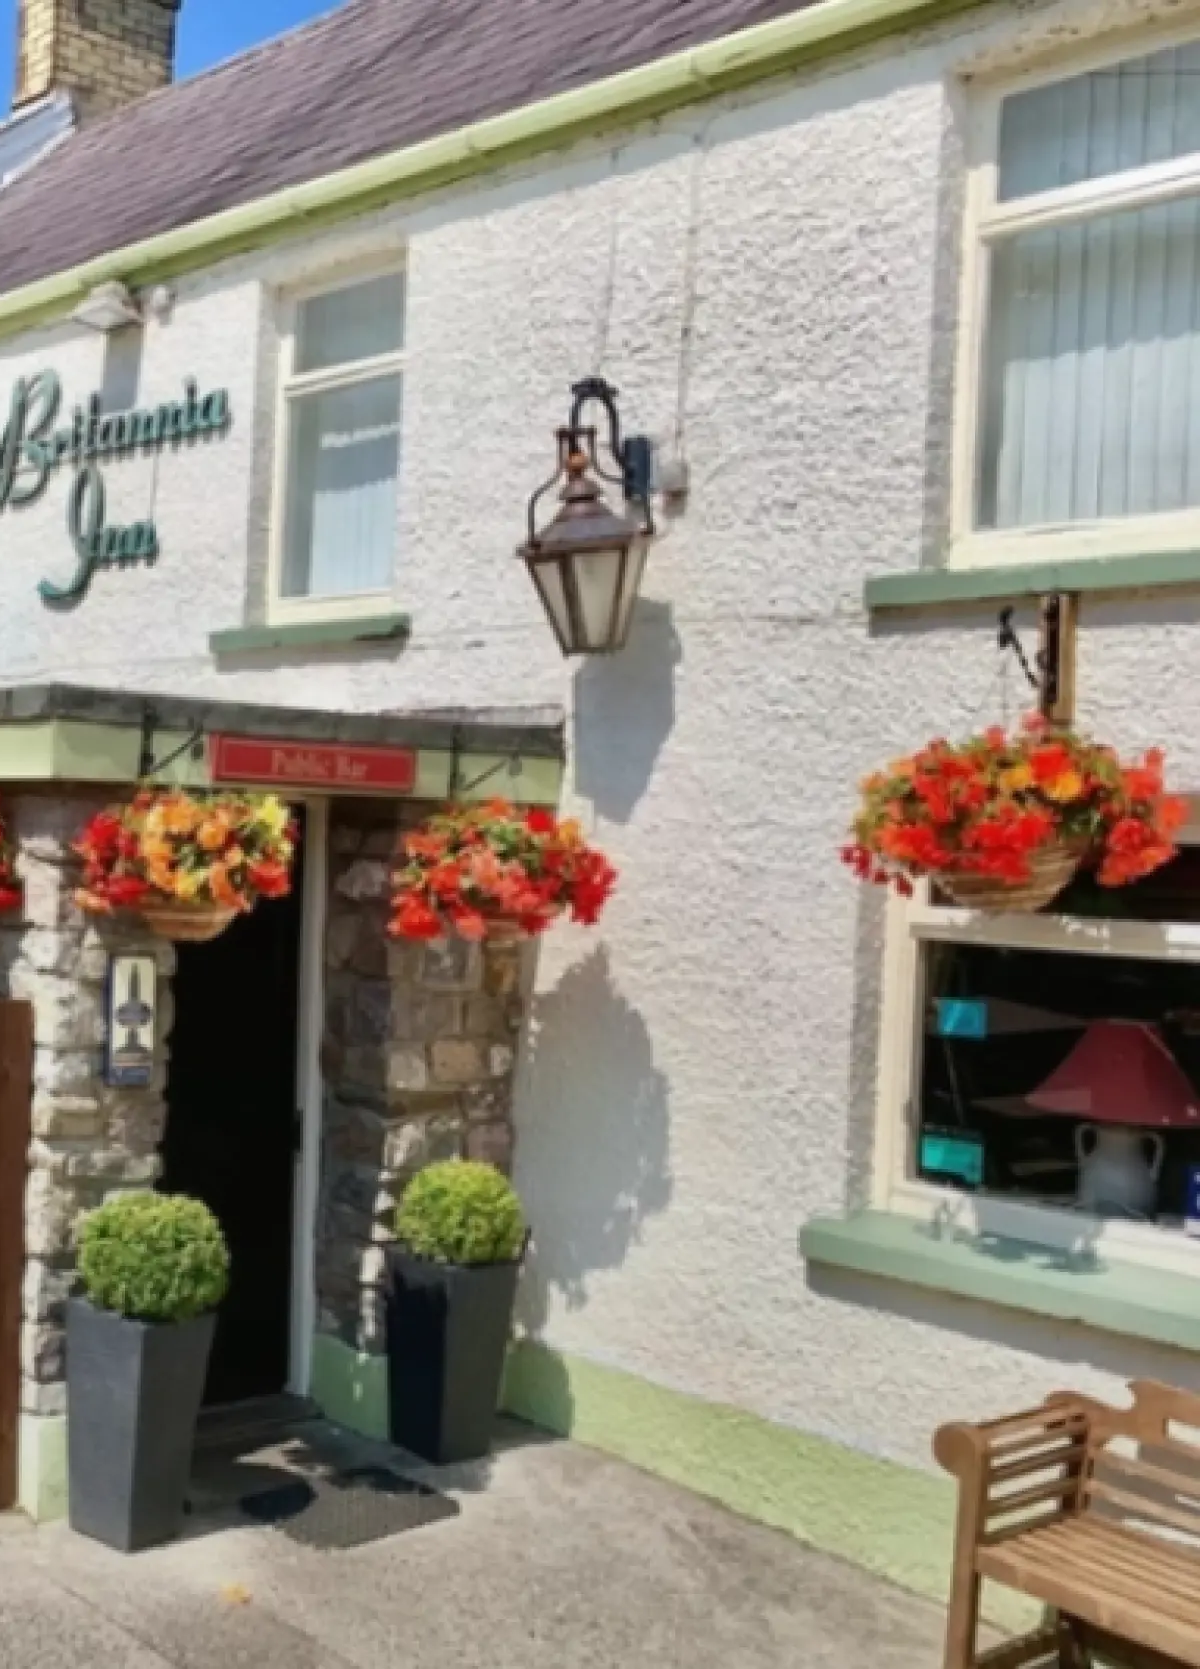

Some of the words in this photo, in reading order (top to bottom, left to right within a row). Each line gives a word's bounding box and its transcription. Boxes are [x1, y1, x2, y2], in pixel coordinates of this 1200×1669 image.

[37, 464, 158, 608] Inn
[271, 748, 330, 777] Public
[335, 752, 369, 780] Bar
